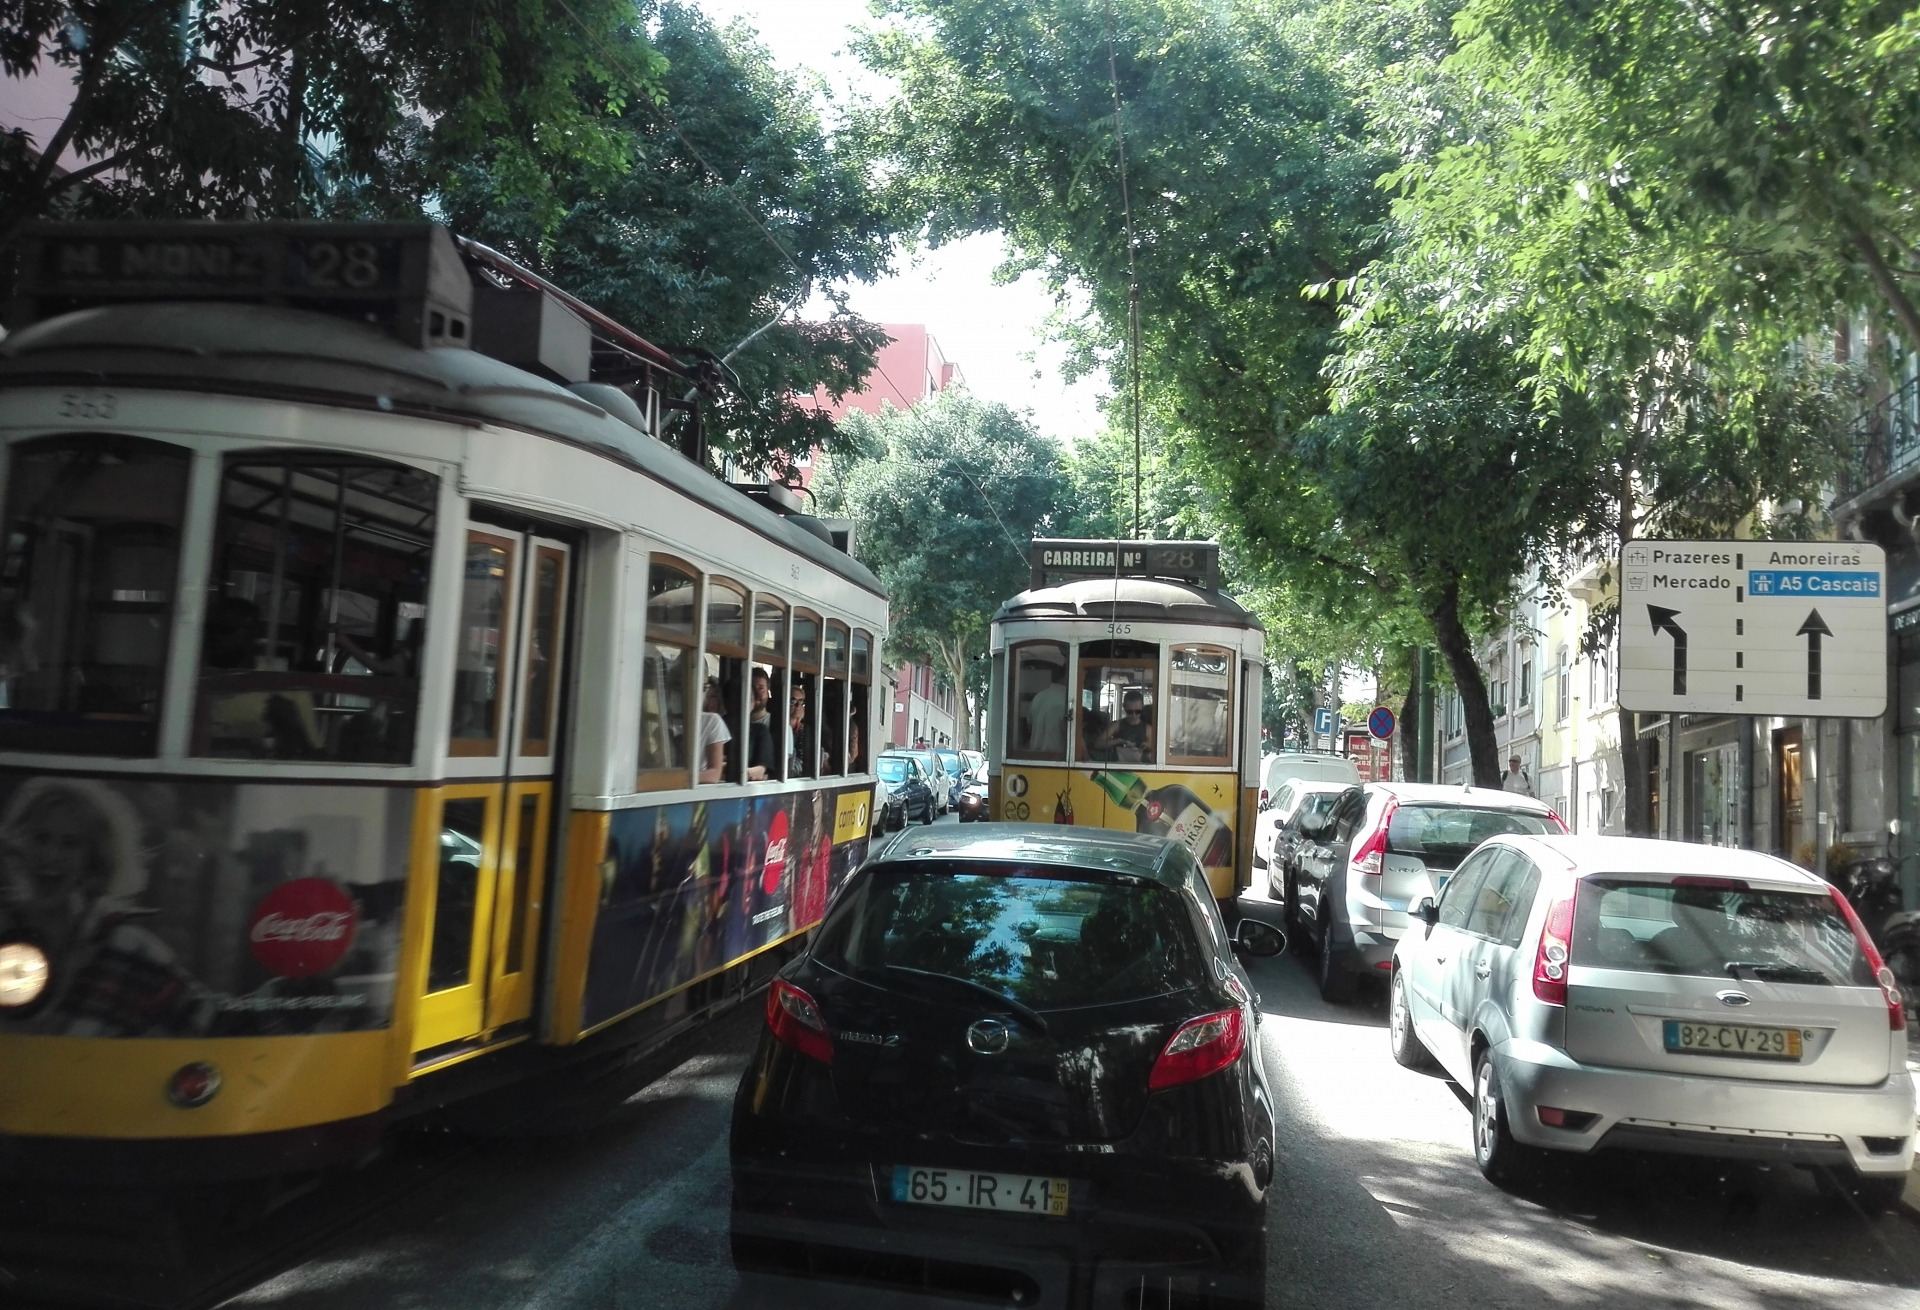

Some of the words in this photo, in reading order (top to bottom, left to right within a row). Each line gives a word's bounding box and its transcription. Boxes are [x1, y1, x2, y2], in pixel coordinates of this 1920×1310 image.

[308, 242, 380, 287] 28
[1043, 550, 1115, 566] CARREIRA
[1161, 550, 1195, 569] 28
[1653, 550, 1731, 565] Prazeres
[1769, 551, 1861, 566] Amoreiras
[1653, 575, 1731, 589] Mercado
[1780, 576, 1802, 591] A5
[1807, 576, 1878, 592] Cascais
[1107, 624, 1131, 635] 565
[1056, 1182, 1067, 1194] 10
